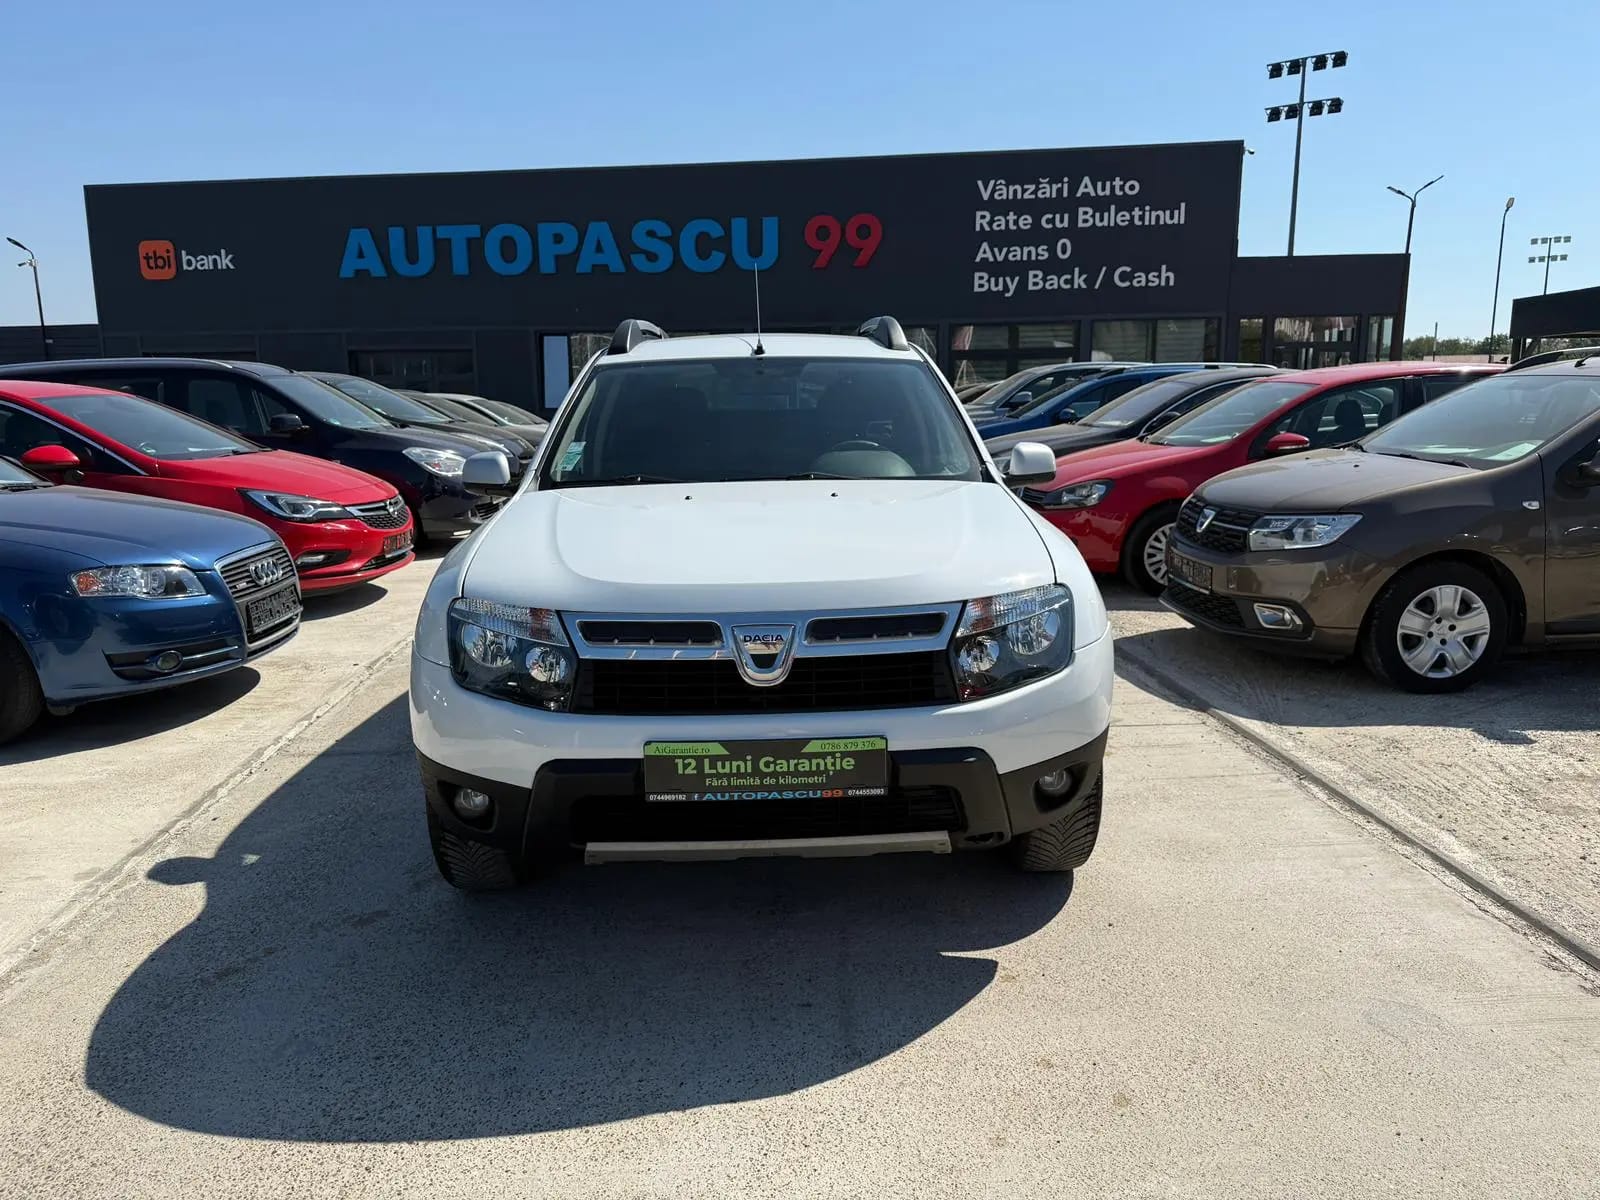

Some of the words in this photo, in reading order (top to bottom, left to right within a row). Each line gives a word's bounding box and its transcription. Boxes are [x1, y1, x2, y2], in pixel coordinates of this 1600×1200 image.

[977, 177, 1069, 201] Vânzări
[1075, 176, 1141, 197] Auto
[975, 210, 1033, 232] Rate
[1040, 212, 1069, 229] cu
[1077, 202, 1186, 228] Buletinul
[339, 216, 779, 279] AUTOPASCU
[803, 213, 883, 270] 99
[975, 241, 1049, 263] Avans
[1056, 238, 1072, 260] 0
[143, 248, 172, 270] tbi
[181, 248, 236, 271] bank
[973, 271, 1020, 297] Buy
[1027, 267, 1088, 291] Back
[1094, 266, 1107, 290] /
[1113, 264, 1175, 287] Cash
[743, 634, 784, 642] DACIA
[654, 744, 711, 755] AiGarantie.ro
[820, 742, 841, 751] 0786
[843, 741, 859, 751] 879
[860, 740, 876, 749] 376
[674, 758, 697, 775] 12
[703, 755, 752, 774] Luni
[759, 752, 856, 776] Garanție
[705, 776, 728, 787] Fără
[730, 775, 761, 786] limită
[763, 775, 777, 785] de
[778, 774, 826, 785] kilometri
